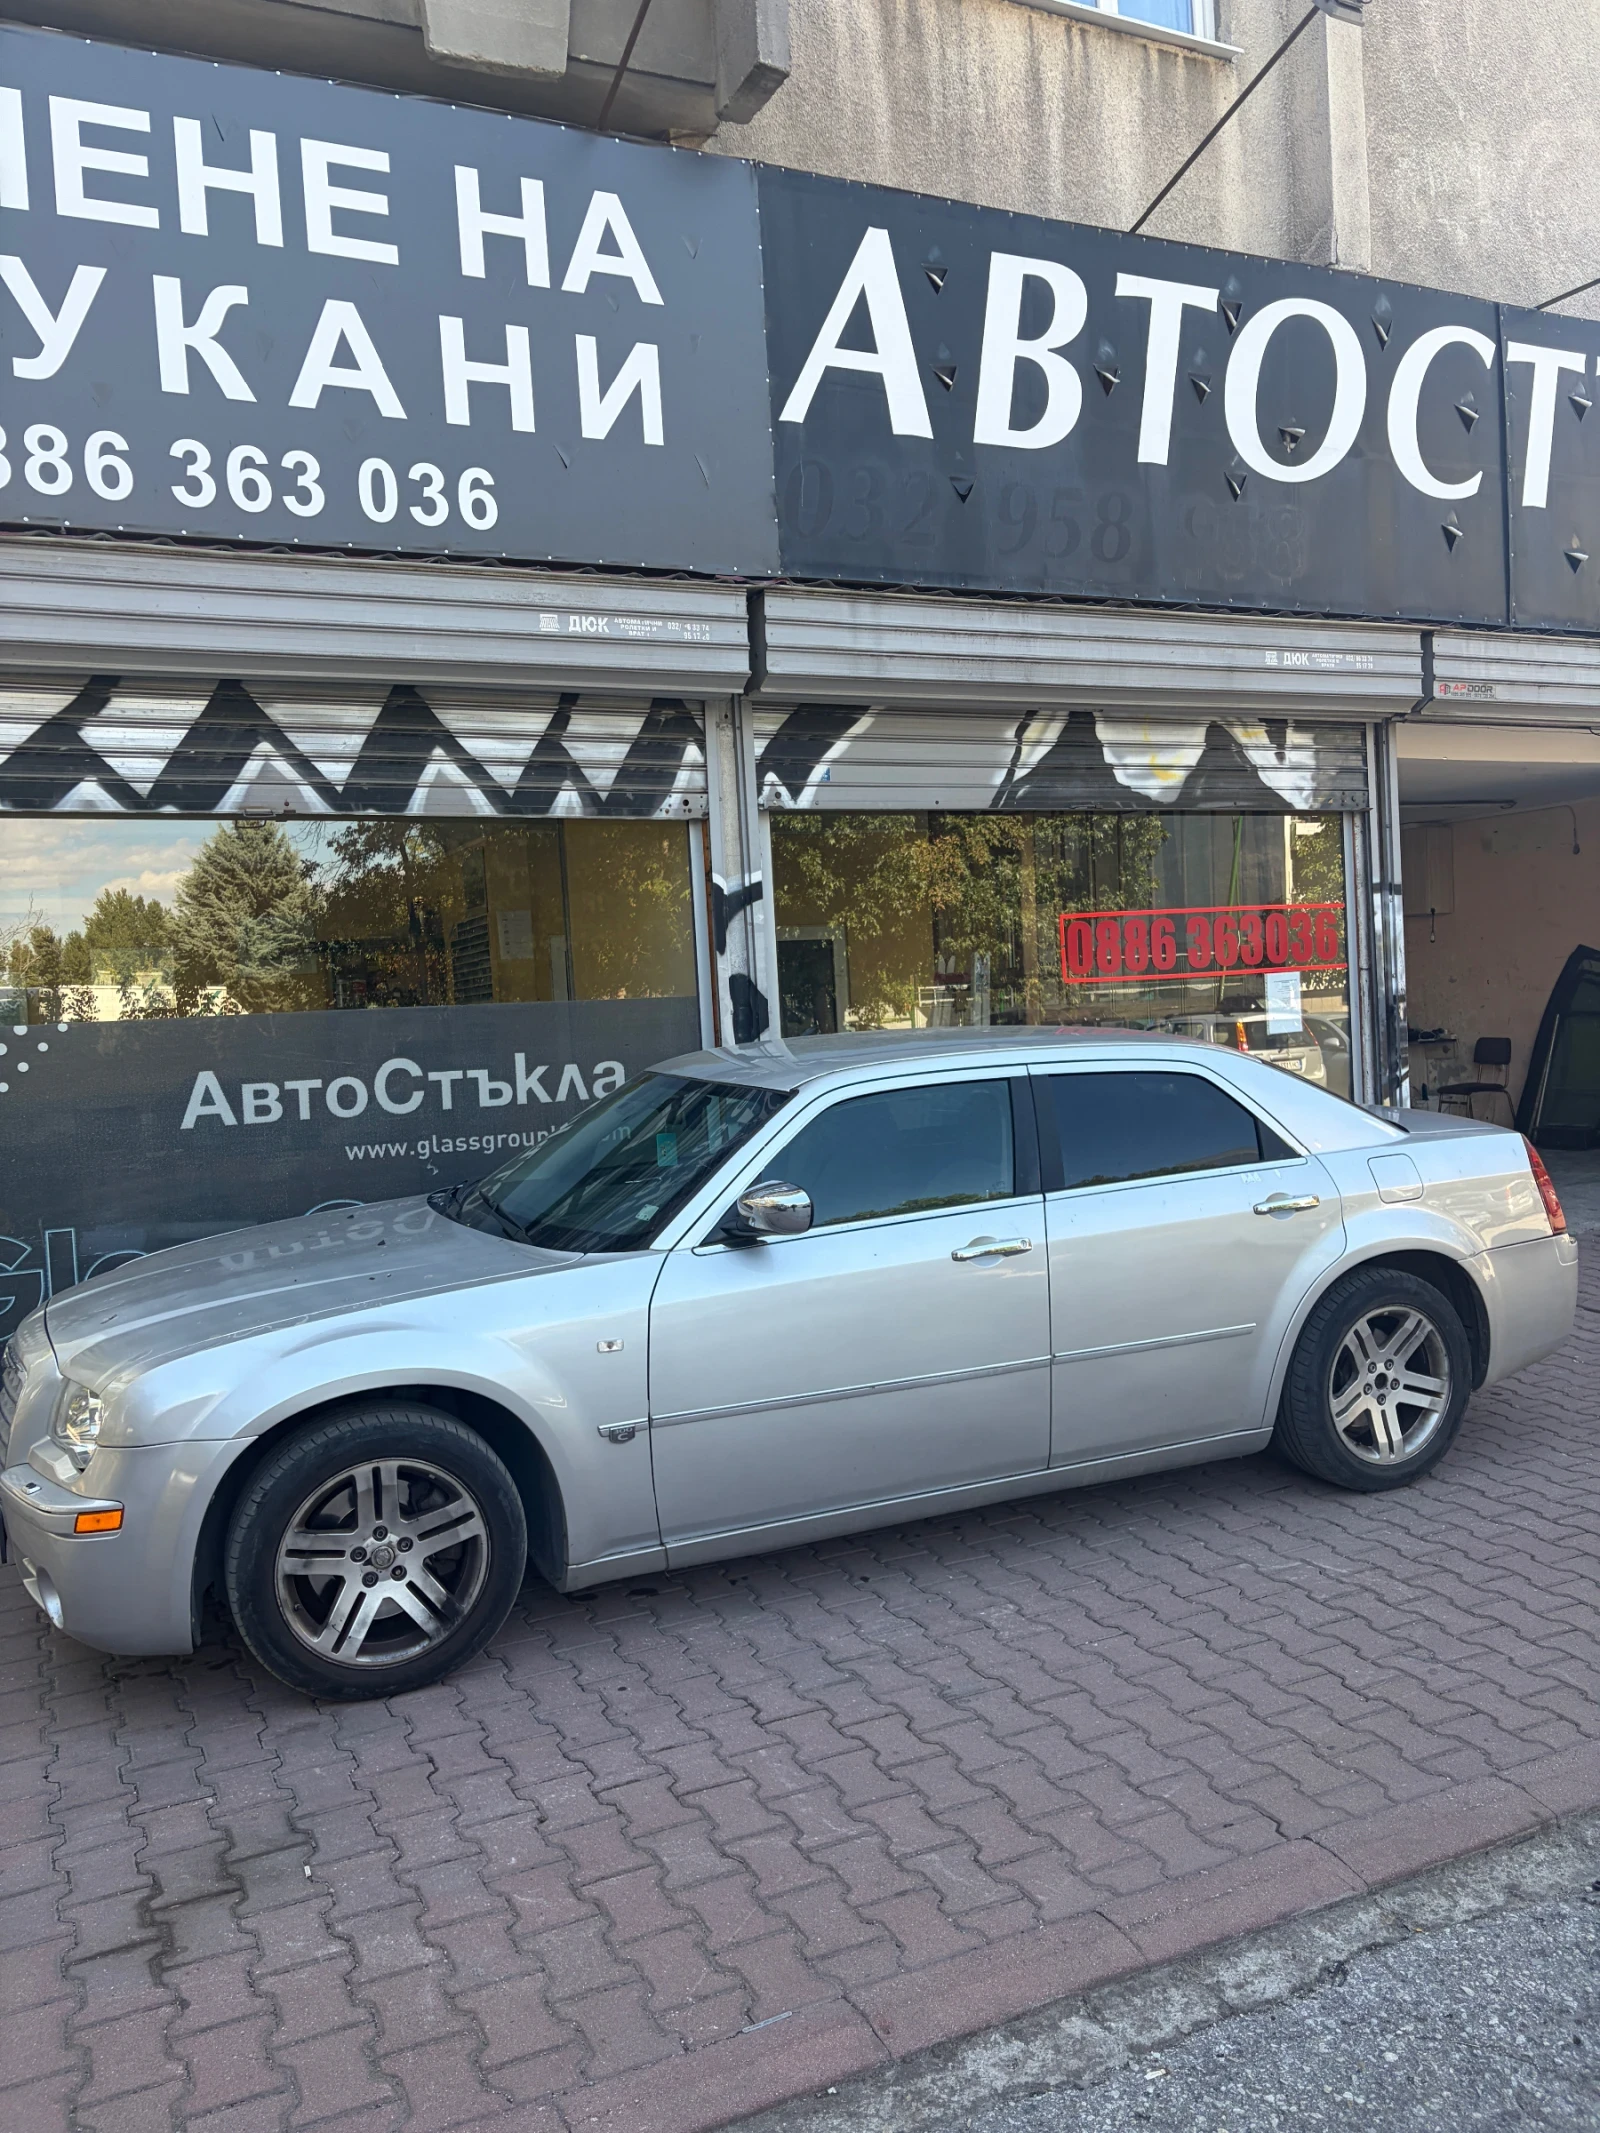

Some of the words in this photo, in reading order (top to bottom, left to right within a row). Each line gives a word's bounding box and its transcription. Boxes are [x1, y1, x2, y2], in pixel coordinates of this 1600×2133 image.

[453, 164, 665, 307] НА
[778, 226, 1600, 509] АВТОСТ
[170, 438, 326, 518] 363
[358, 457, 500, 531] 036
[568, 614, 610, 633] ДЮК
[1283, 651, 1310, 666] ДЮК
[1067, 918, 1177, 975] 0886
[1186, 911, 1339, 969] 363036
